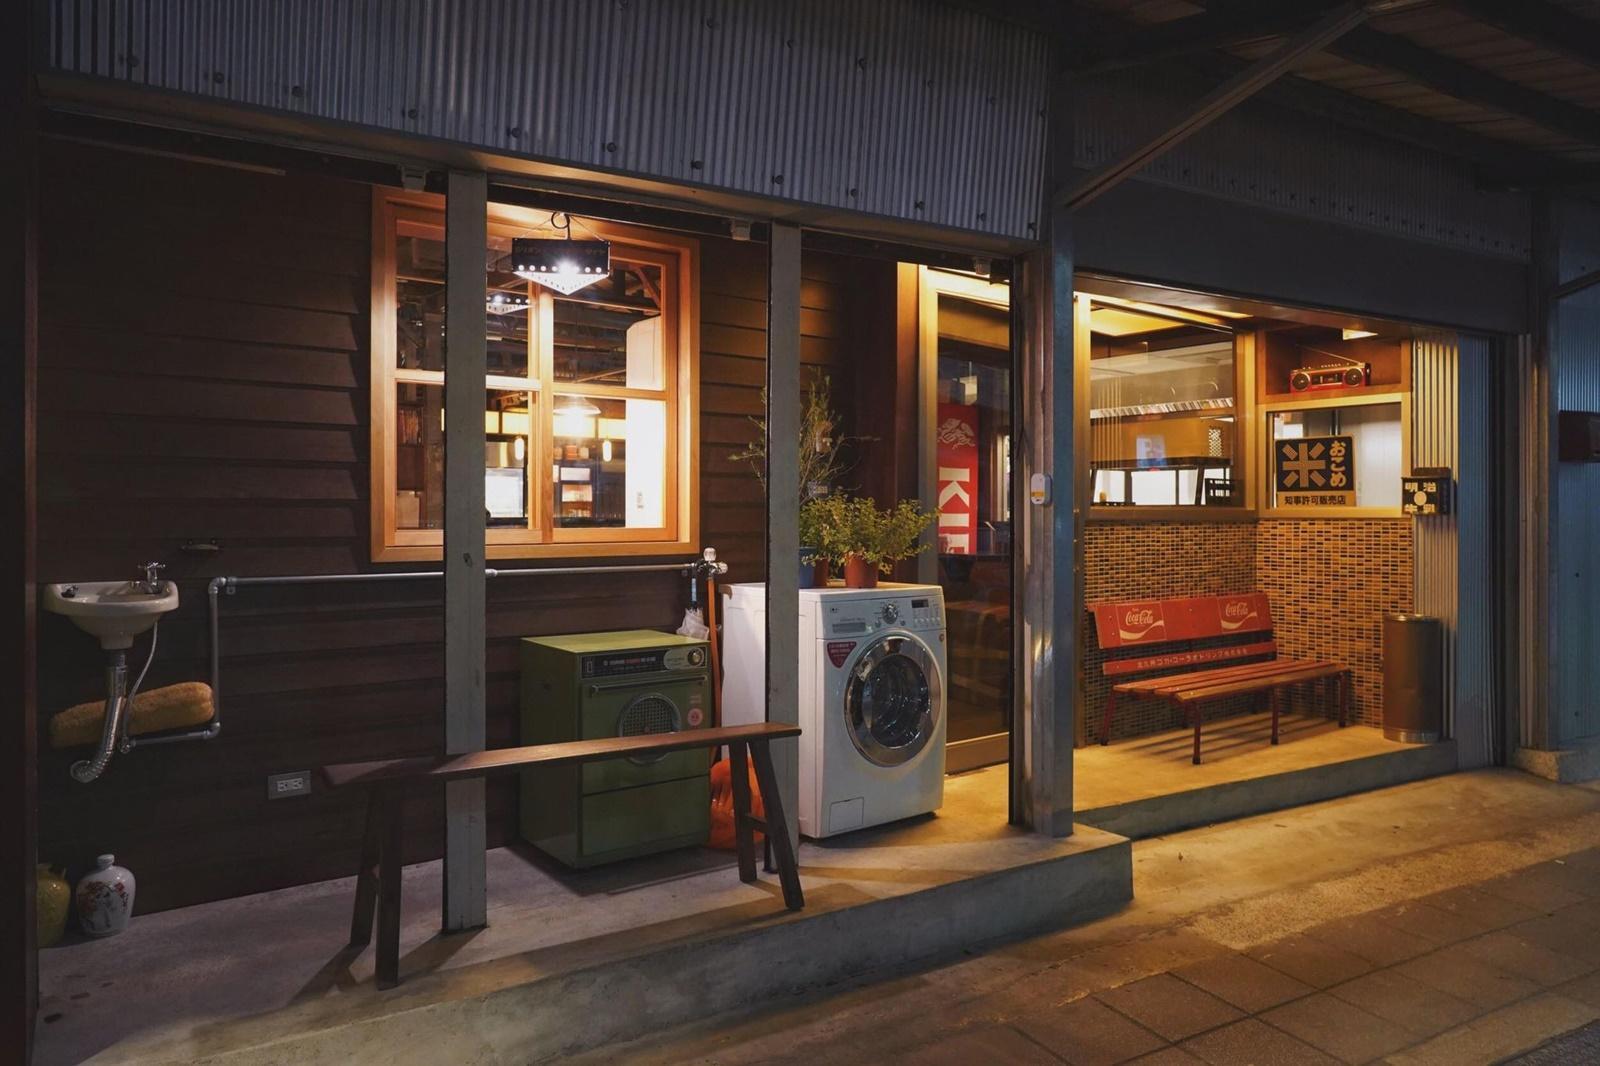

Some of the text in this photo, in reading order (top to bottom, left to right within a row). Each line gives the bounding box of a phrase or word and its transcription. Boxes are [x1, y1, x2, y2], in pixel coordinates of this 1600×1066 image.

[1282, 442, 1326, 488] 米
[1329, 441, 1347, 488] おこめ
[1284, 495, 1346, 505] 知事許可販売店
